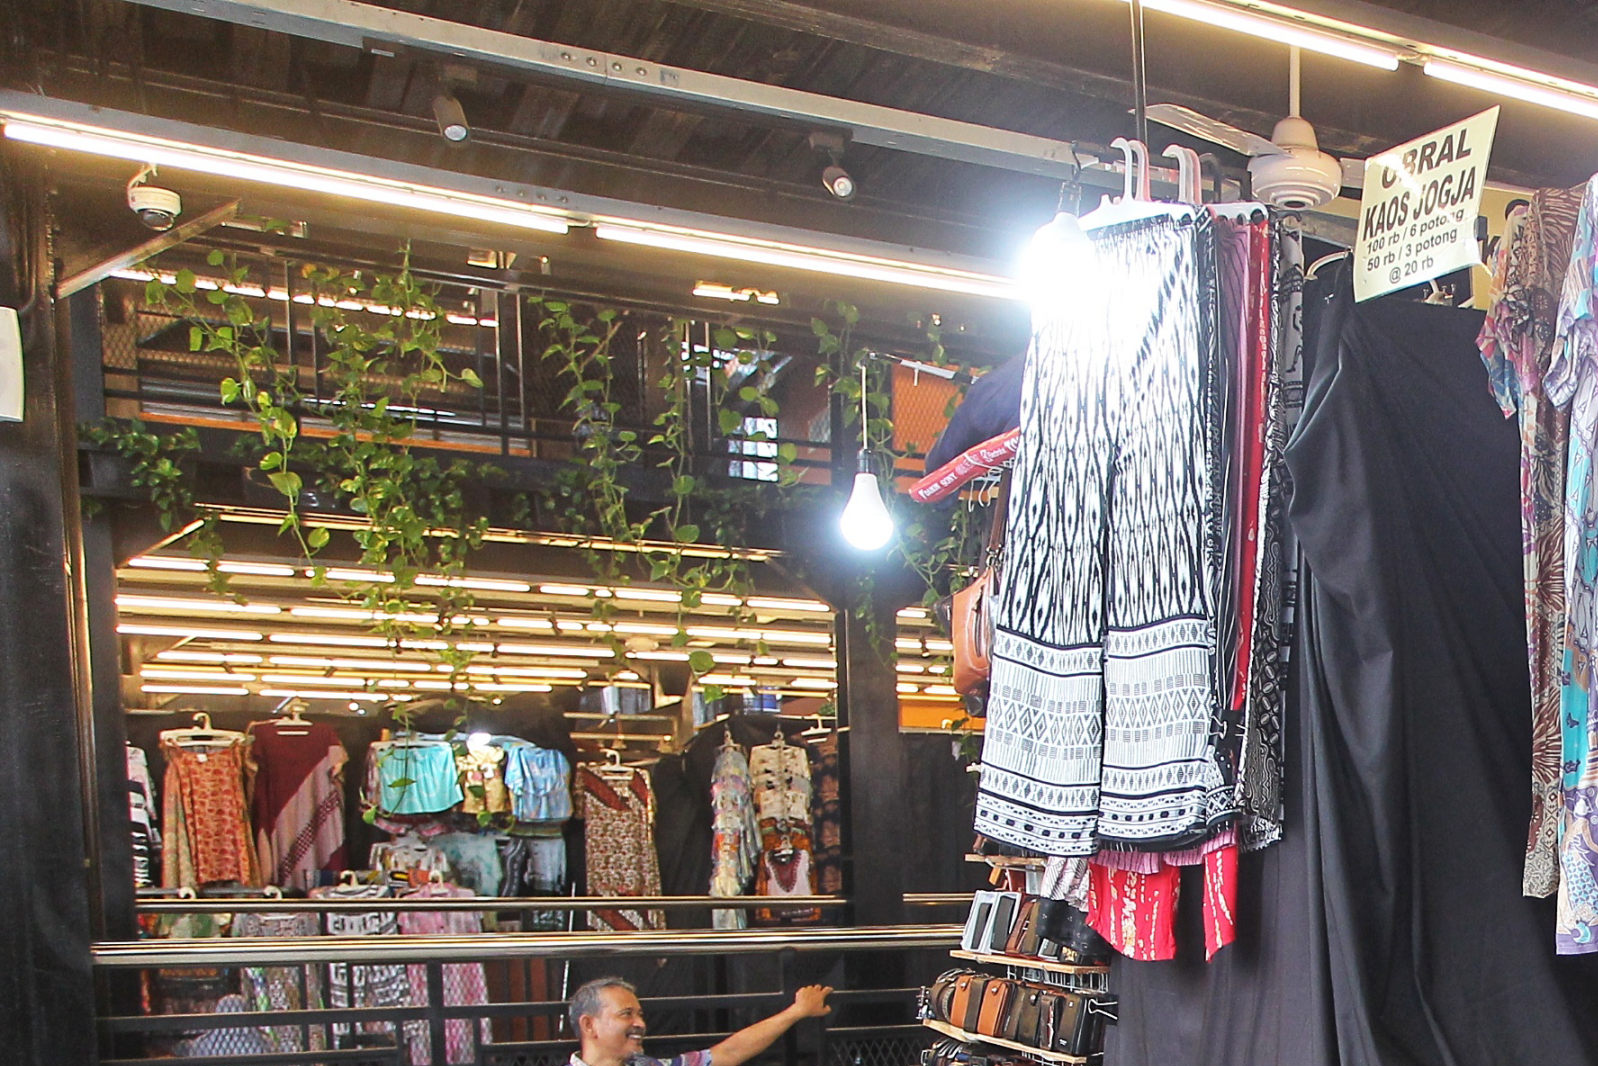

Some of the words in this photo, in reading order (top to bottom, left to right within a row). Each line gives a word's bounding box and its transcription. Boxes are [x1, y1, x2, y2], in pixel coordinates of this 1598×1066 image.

[1363, 191, 1410, 241] KAOS
[1413, 166, 1476, 220] JOGJA
[1367, 236, 1385, 255] 100
[1388, 231, 1400, 245] rb
[1403, 227, 1408, 241] /
[1410, 224, 1417, 237] 6
[1420, 208, 1464, 236] potog
[1367, 258, 1380, 271] 50
[1383, 253, 1395, 267] rb
[1398, 248, 1403, 261] /
[1405, 244, 1412, 257] 3
[1416, 228, 1457, 257] potong
[1389, 267, 1401, 283] @
[1404, 261, 1418, 276] 20
[1421, 256, 1434, 271] rb
